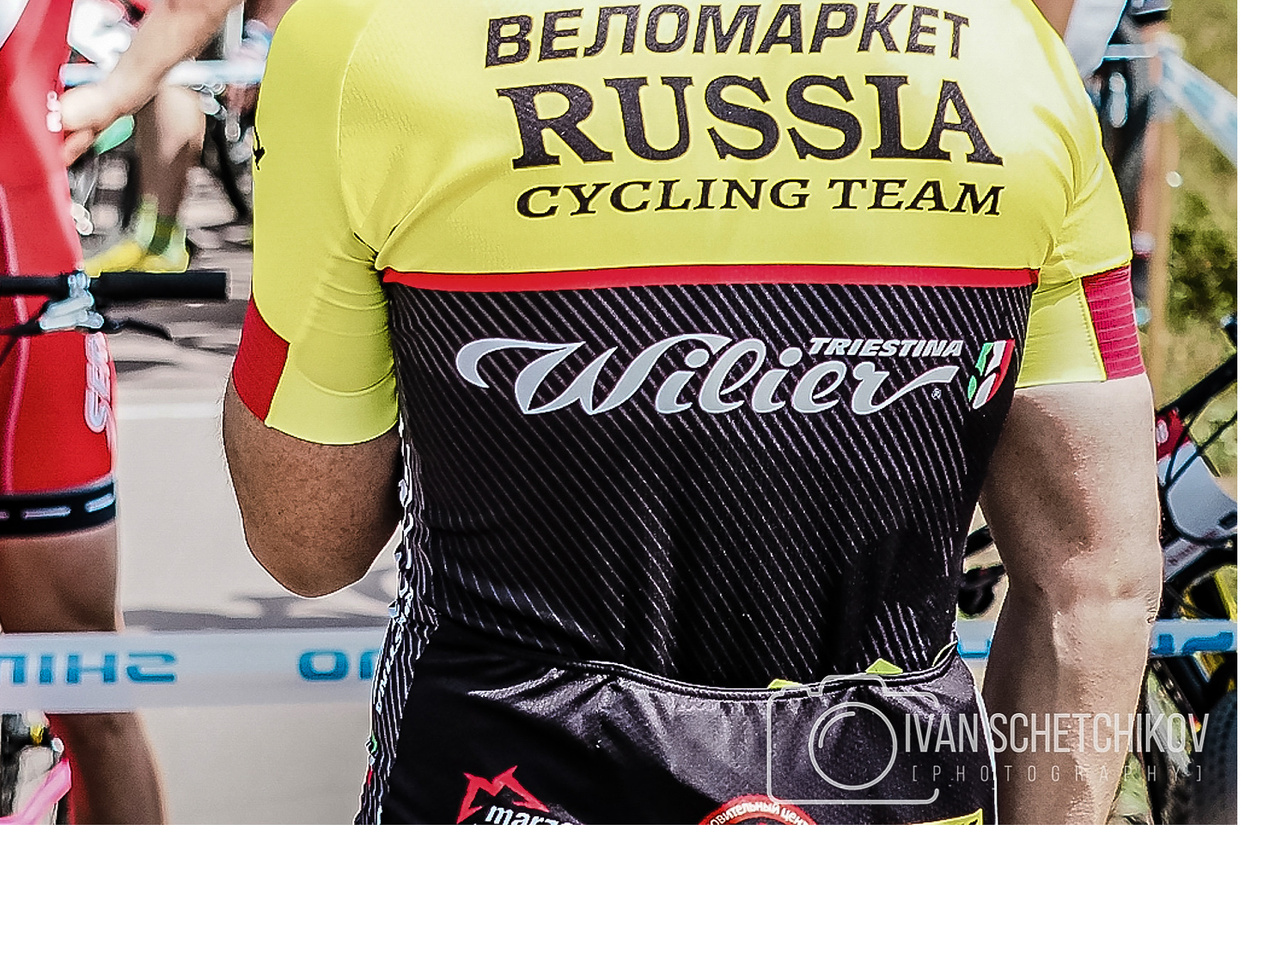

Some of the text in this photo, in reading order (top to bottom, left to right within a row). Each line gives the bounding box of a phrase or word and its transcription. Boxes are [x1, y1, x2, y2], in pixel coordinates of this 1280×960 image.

[485, 2, 970, 68] ВЕЛОМАРКЕТ
[496, 75, 1004, 169] RUSSIA
[517, 179, 1005, 218] CYCLING TEAM
[456, 333, 960, 415] Wilier
[808, 337, 964, 358] TRIESTINA
